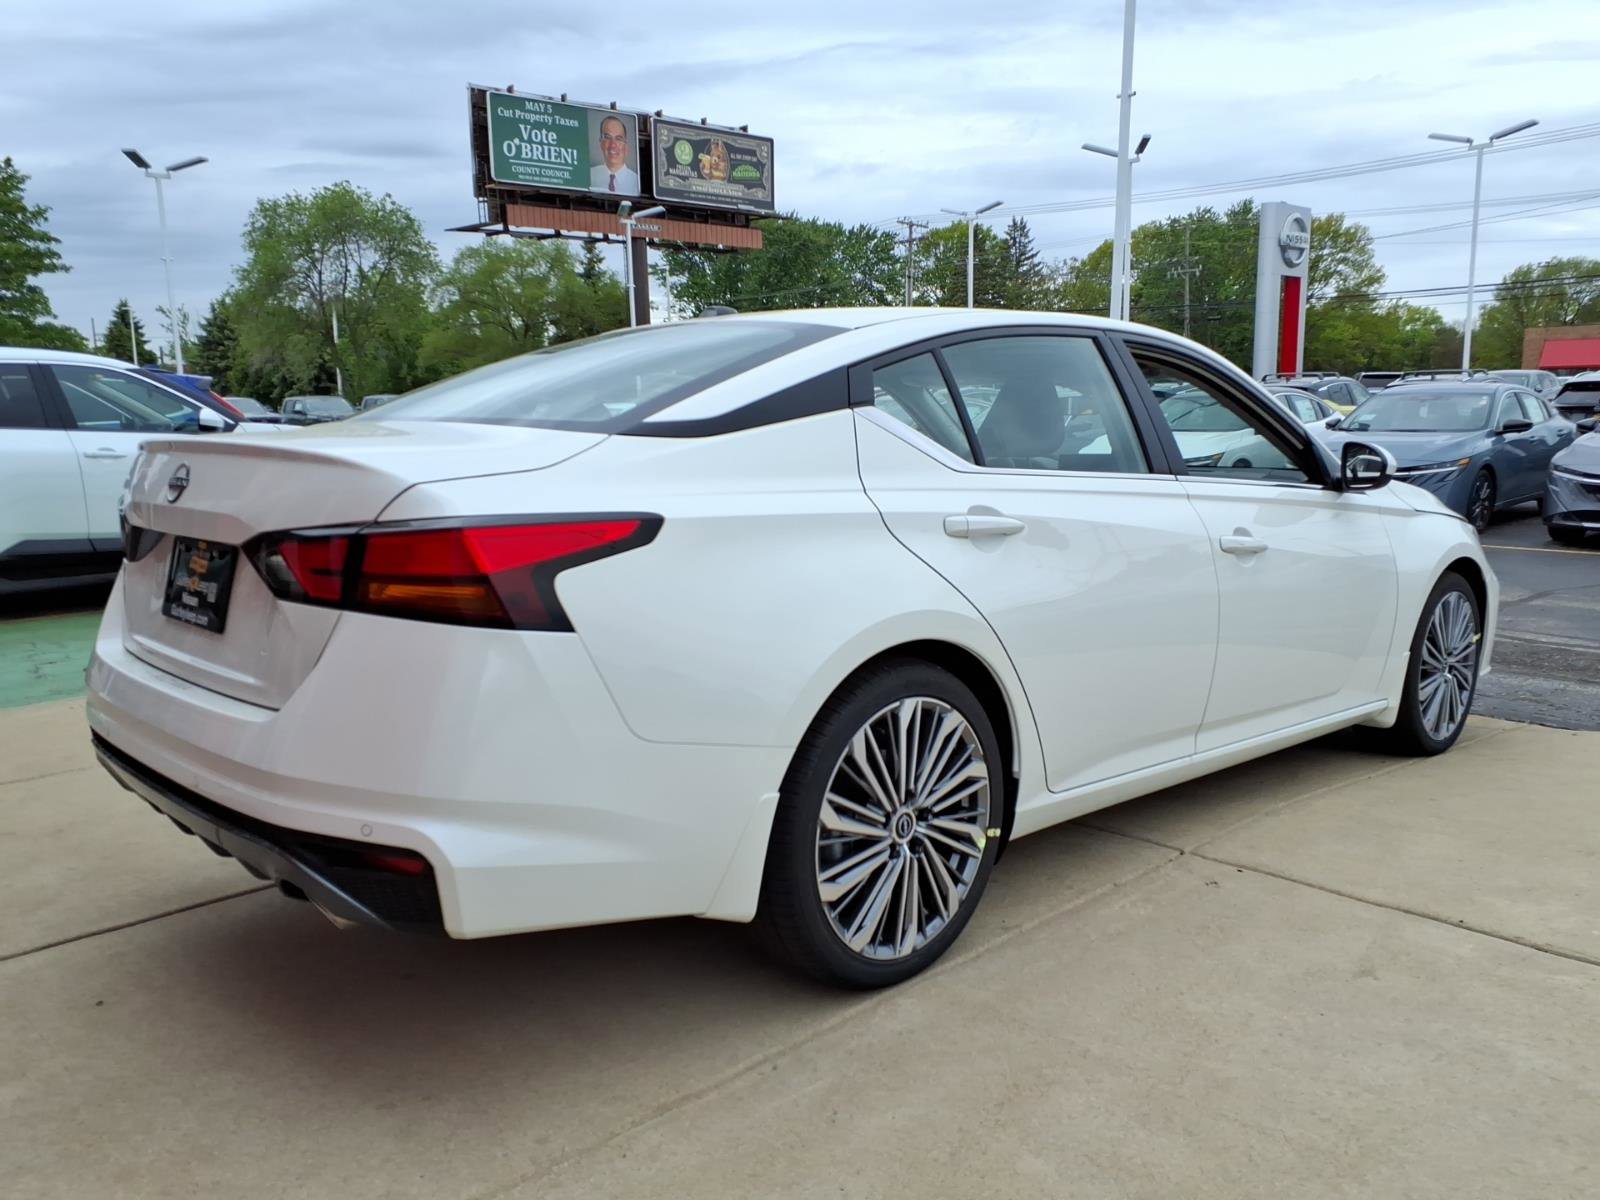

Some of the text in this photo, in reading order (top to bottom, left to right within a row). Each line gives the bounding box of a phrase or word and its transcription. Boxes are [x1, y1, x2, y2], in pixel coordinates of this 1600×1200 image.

[525, 101, 552, 113] MAY 5
[497, 107, 579, 127] Cut Property Taxes
[519, 123, 557, 145] Vote
[511, 165, 540, 175] COUNTY
[541, 168, 572, 179] COUNCIL
[1285, 234, 1308, 244] NISSA
